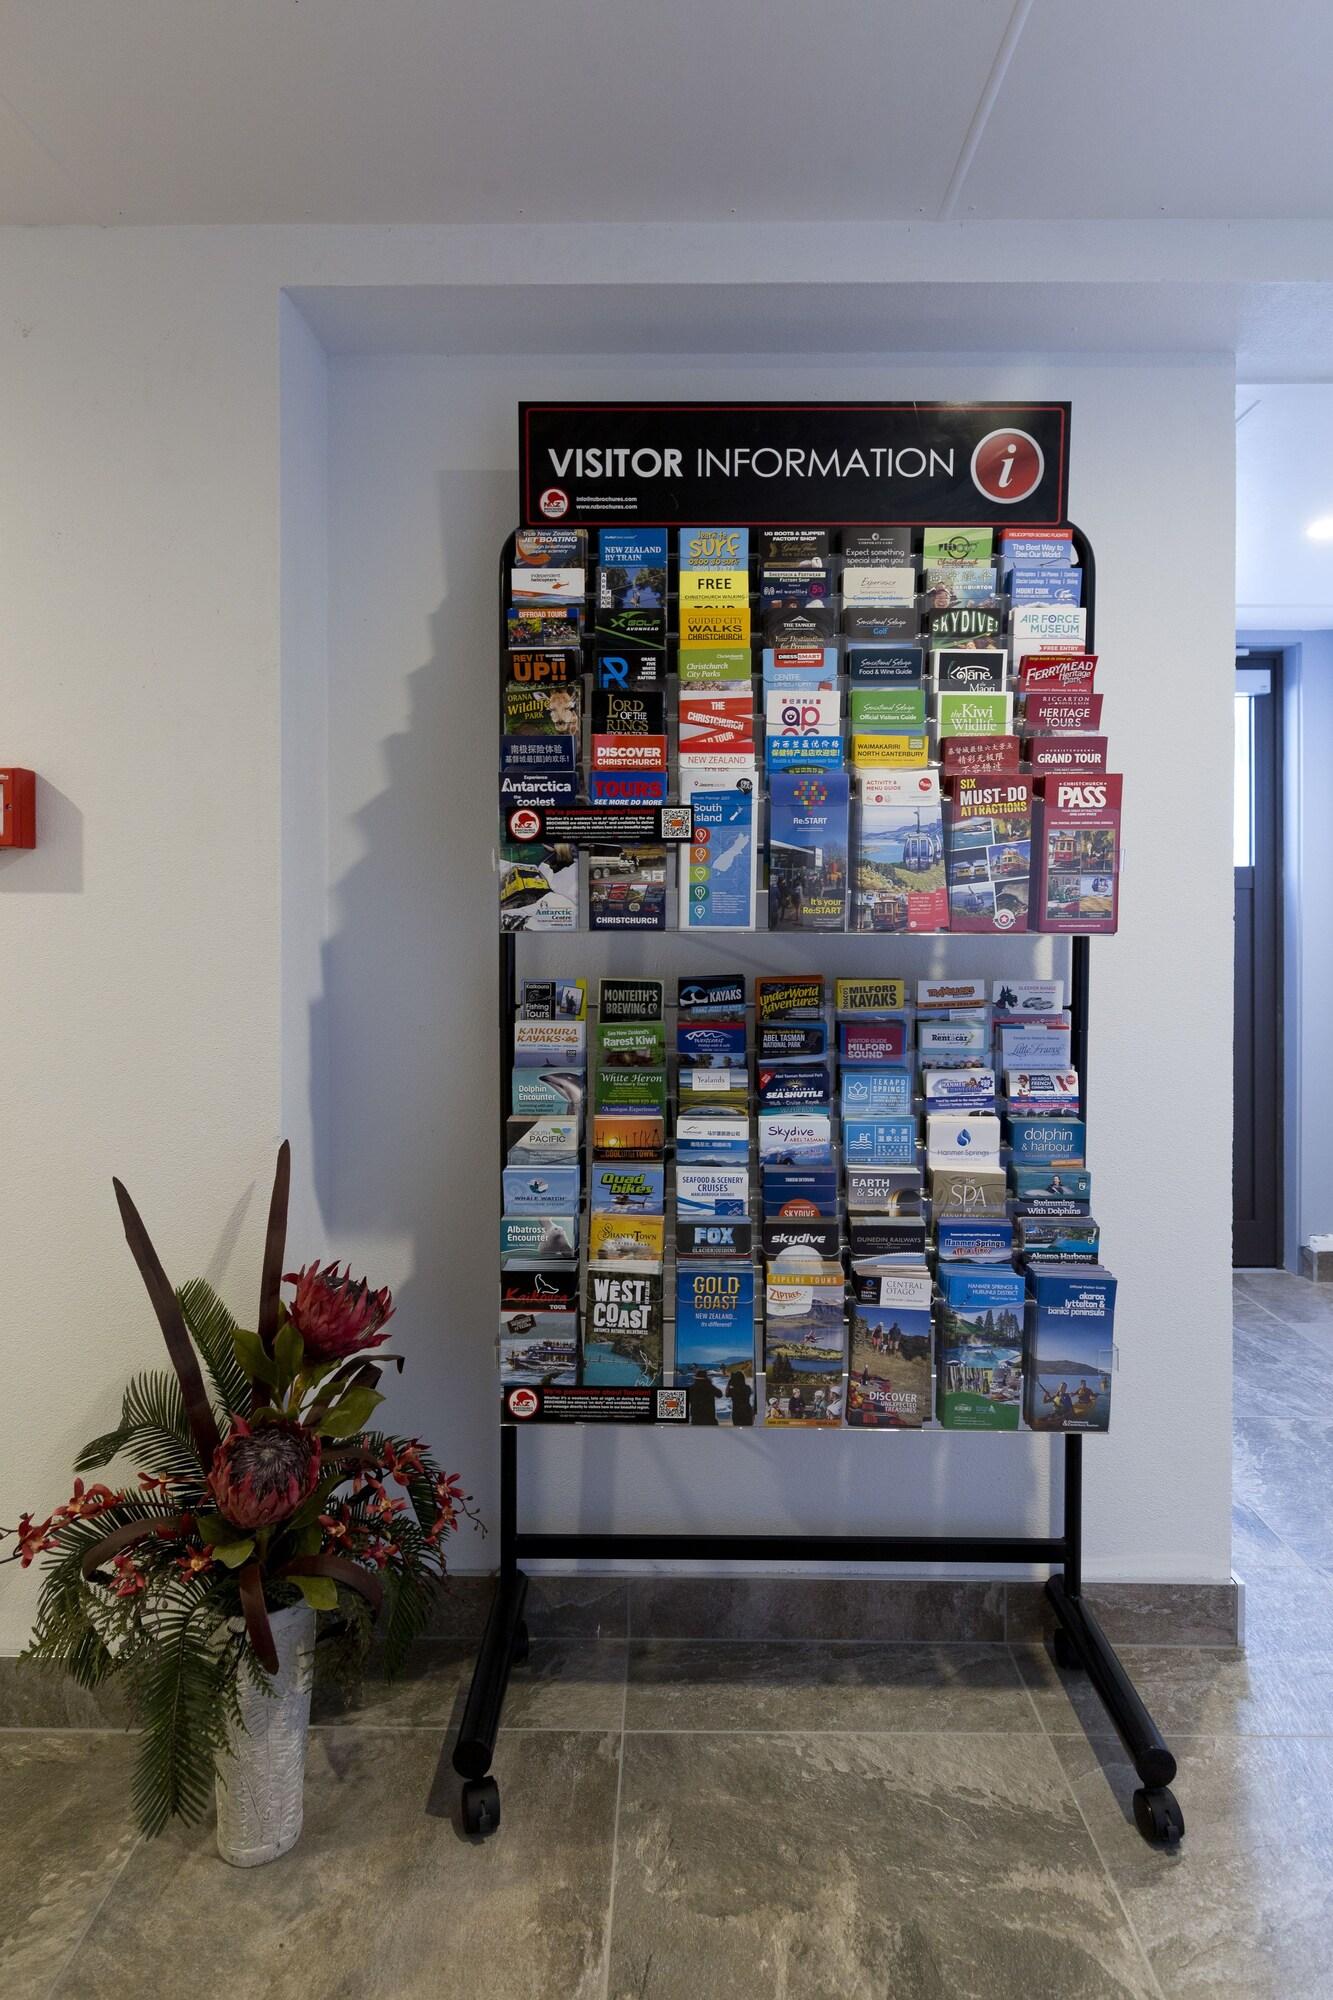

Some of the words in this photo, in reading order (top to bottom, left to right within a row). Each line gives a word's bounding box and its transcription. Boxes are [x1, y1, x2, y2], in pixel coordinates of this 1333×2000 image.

[548, 448, 683, 478] VISITOR
[698, 448, 954, 478] INFORMATION
[698, 578, 731, 590] FREE
[932, 610, 998, 633] SKYDIVE!
[1020, 615, 1038, 623] AIR
[1042, 614, 1080, 623] FORCE
[1031, 624, 1079, 633] MUSEUM
[514, 663, 566, 680] UP!!
[508, 699, 550, 716] Wildlife
[712, 702, 725, 710] THE
[1039, 708, 1090, 717] HERITAGE
[607, 720, 648, 731] RINGS
[688, 711, 744, 731] CHRISTCHURCH
[951, 718, 997, 731] Wildlife
[1046, 718, 1081, 727] TOURS
[597, 747, 661, 757] DISCOVER
[1037, 754, 1072, 763] GRAND
[1075, 754, 1101, 763] TOUR
[501, 778, 571, 792] Antarctica
[594, 781, 663, 798] TOURS
[960, 778, 976, 789] SIX
[960, 786, 1027, 806] MUST-DO
[1058, 786, 1106, 808] PASS
[694, 803, 722, 812] South
[960, 802, 1027, 816] ATTRACTIONS
[850, 985, 896, 994] MILFORD
[604, 990, 658, 1002] MONTEITH'S
[709, 989, 742, 1003] KAYAKS
[850, 993, 897, 1008] KAYAKS
[526, 1010, 550, 1018] Tours
[604, 1038, 633, 1047] Rarest
[635, 1036, 656, 1045] Kiwi
[697, 1076, 725, 1084] Yealands
[519, 1085, 546, 1094] Dolphin
[768, 1127, 814, 1142] Skydive
[1024, 1128, 1073, 1141] dolphin
[1031, 1141, 1073, 1152] harbour
[601, 1173, 645, 1184] Quad
[852, 1179, 890, 1187] EARTH
[868, 1188, 889, 1196] SKY
[950, 1184, 986, 1208] SPA
[1033, 1200, 1075, 1208] Swimming
[694, 1227, 734, 1244] FOX
[771, 1233, 826, 1245] skydive
[693, 1277, 740, 1294] GOLD
[887, 1281, 923, 1289] CENTRAL
[594, 1279, 645, 1304] WEST
[694, 1296, 738, 1310] COAST
[594, 1303, 651, 1328] COAST
[869, 1392, 917, 1402] DISCOVER
